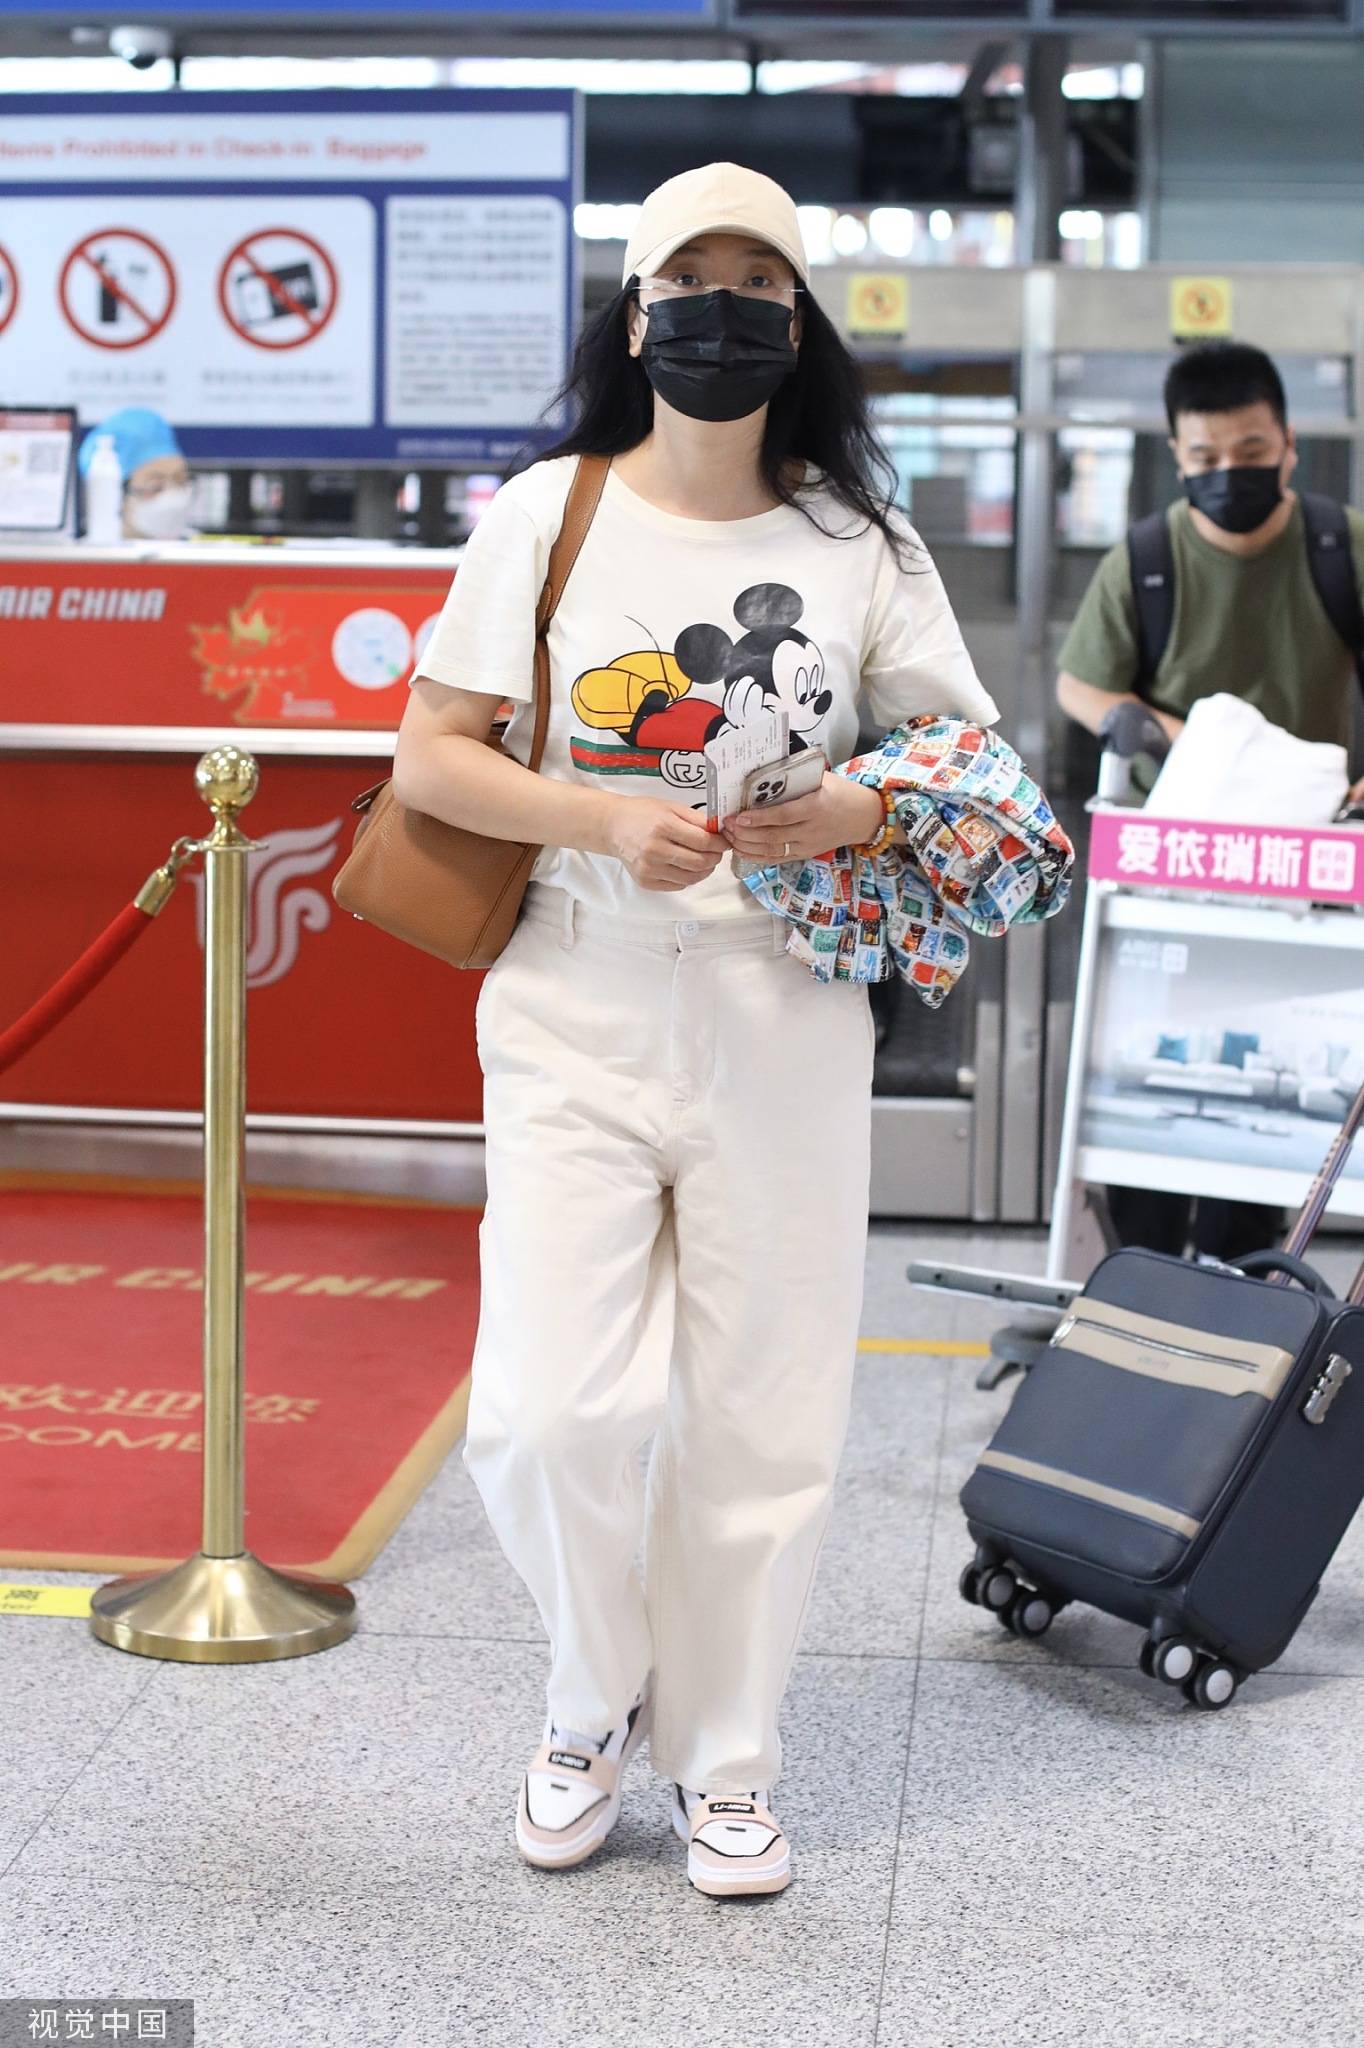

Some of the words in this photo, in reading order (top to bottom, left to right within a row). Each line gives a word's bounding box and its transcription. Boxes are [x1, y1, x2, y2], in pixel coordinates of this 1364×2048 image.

[63, 136, 178, 158] Prohibited
[188, 138, 205, 158] in
[326, 136, 428, 164] Baggage
[0, 585, 53, 621] AIR
[57, 587, 167, 622] CHINA
[1117, 824, 1304, 888] 爱依瑞斯
[0, 1263, 105, 1285] IR
